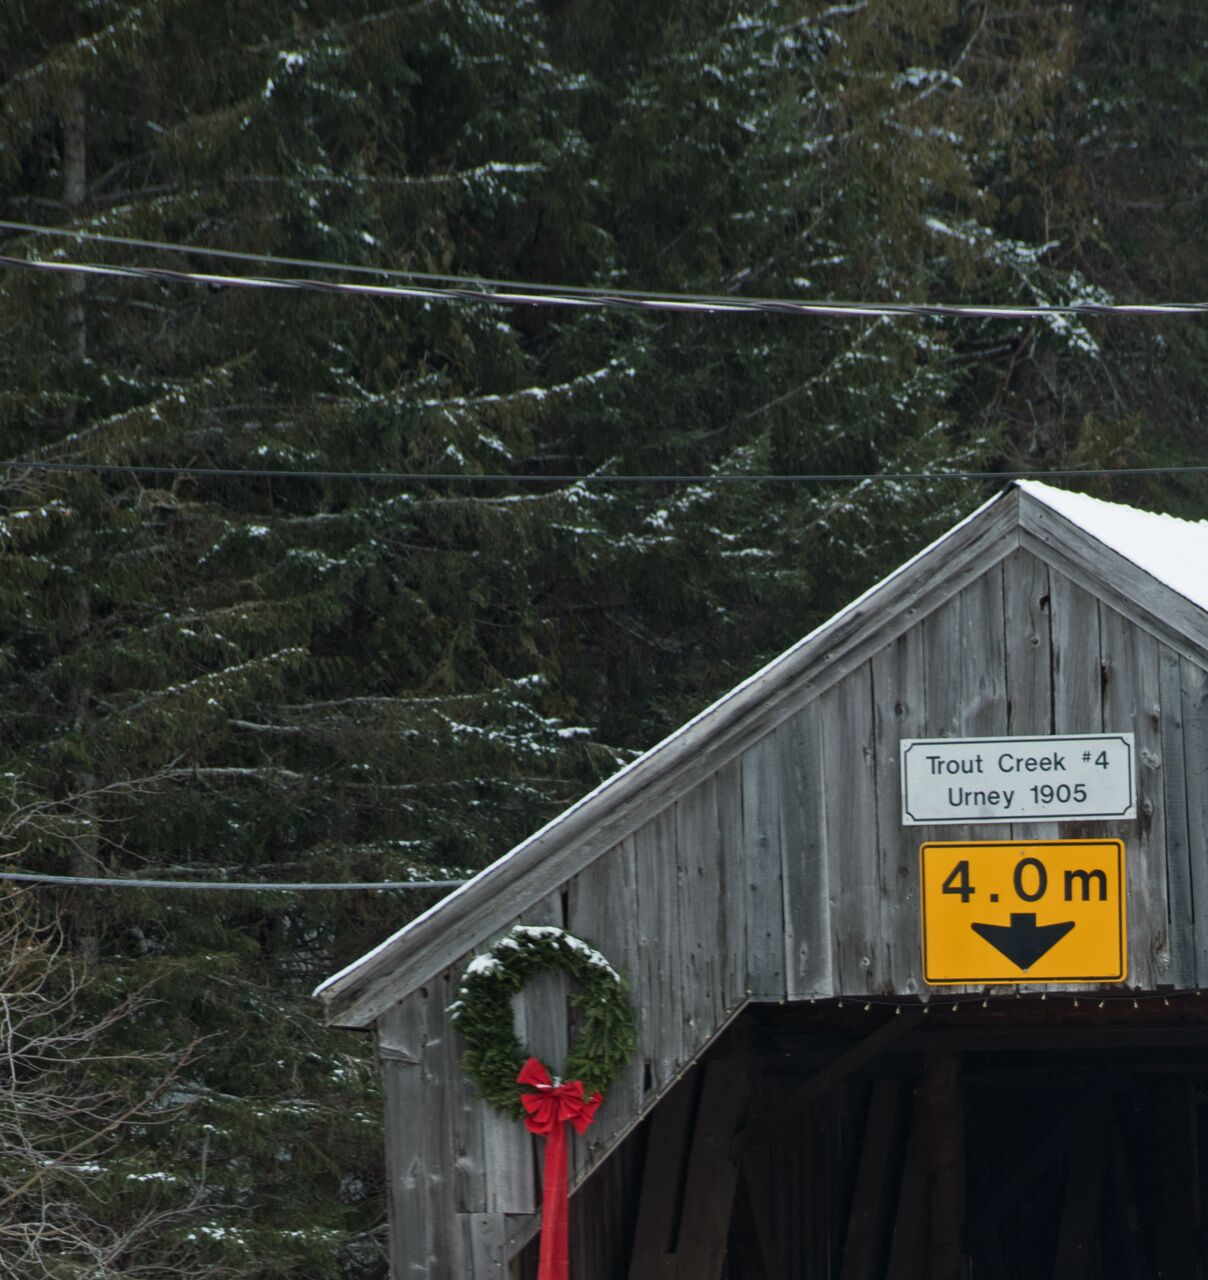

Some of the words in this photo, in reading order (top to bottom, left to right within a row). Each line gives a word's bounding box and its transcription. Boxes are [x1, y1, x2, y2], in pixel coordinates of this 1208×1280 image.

[926, 755, 983, 775] Trout
[998, 752, 1066, 773] Creek
[1082, 750, 1110, 770] #4
[948, 787, 1014, 809] Urney
[1030, 783, 1088, 804] 1905
[942, 857, 1048, 903] 4.0
[1064, 869, 1107, 901] m
